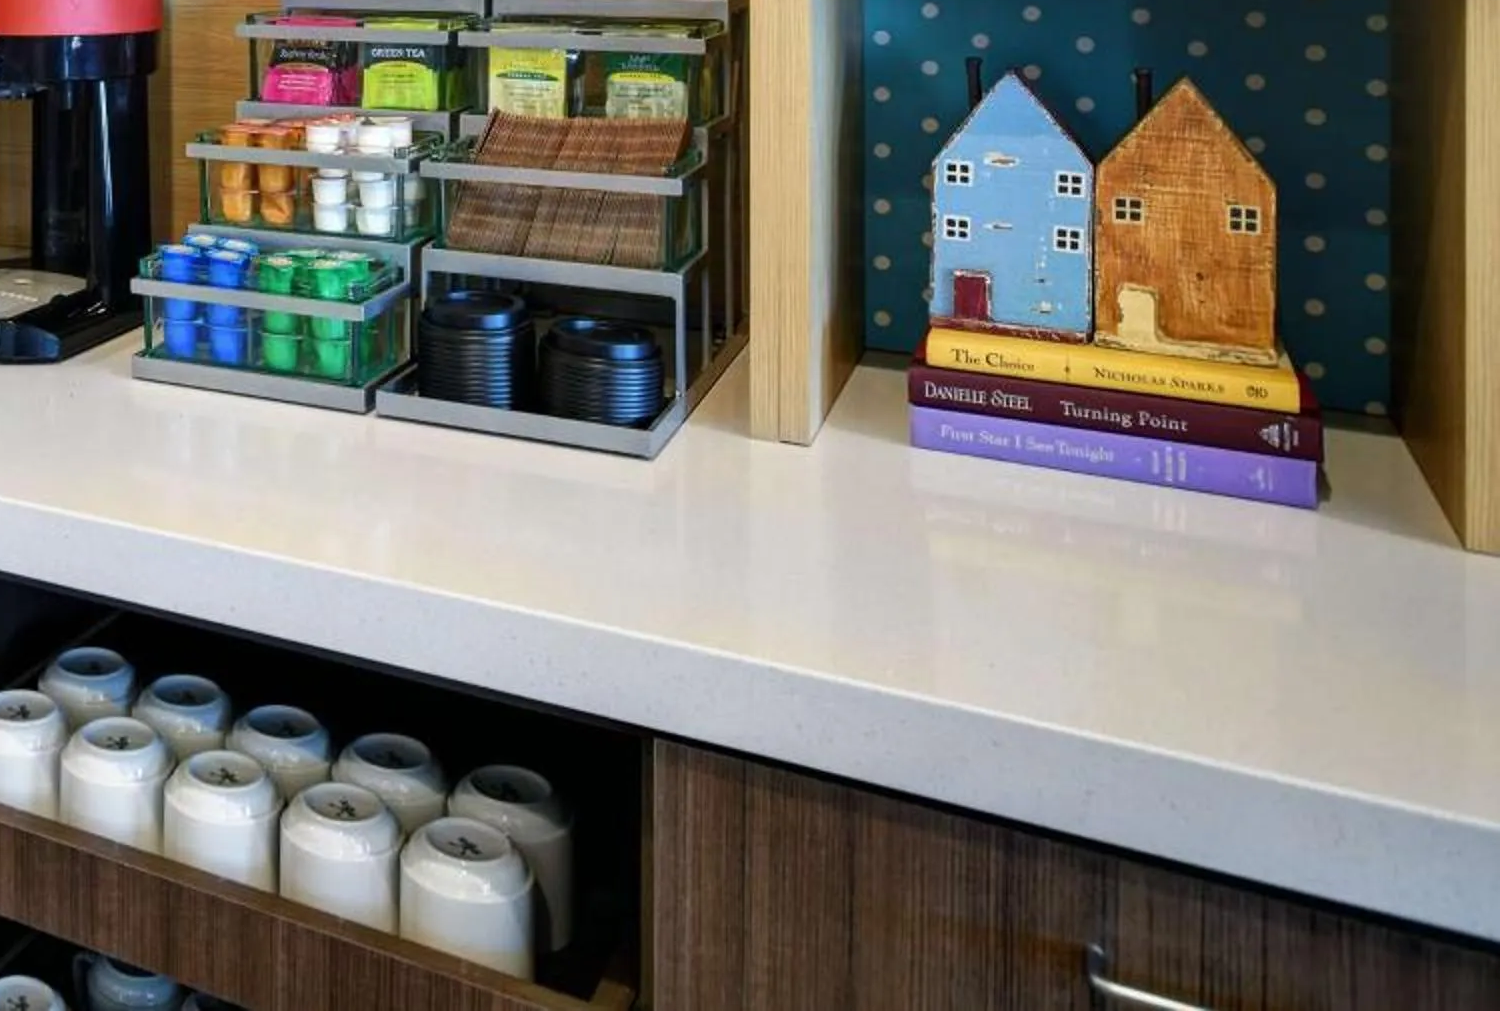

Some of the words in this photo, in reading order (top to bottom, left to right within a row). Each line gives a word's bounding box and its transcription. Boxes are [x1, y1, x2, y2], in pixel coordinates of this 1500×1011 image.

[371, 48, 403, 58] GREEN
[404, 48, 426, 58] TEA
[951, 348, 981, 366] The
[985, 352, 1035, 372] Choice
[1093, 366, 1167, 387] NICHOLAS
[1170, 376, 1226, 395] SPARKS
[924, 380, 988, 406] DANIELLE
[990, 389, 1033, 412] STEEL
[1059, 399, 1133, 428] Turning
[1138, 410, 1189, 432] Point
[940, 424, 974, 443] First
[979, 430, 1008, 448] Star
[1014, 435, 1023, 449] I
[1025, 439, 1054, 454] See
[1054, 440, 1115, 463] Tonight
